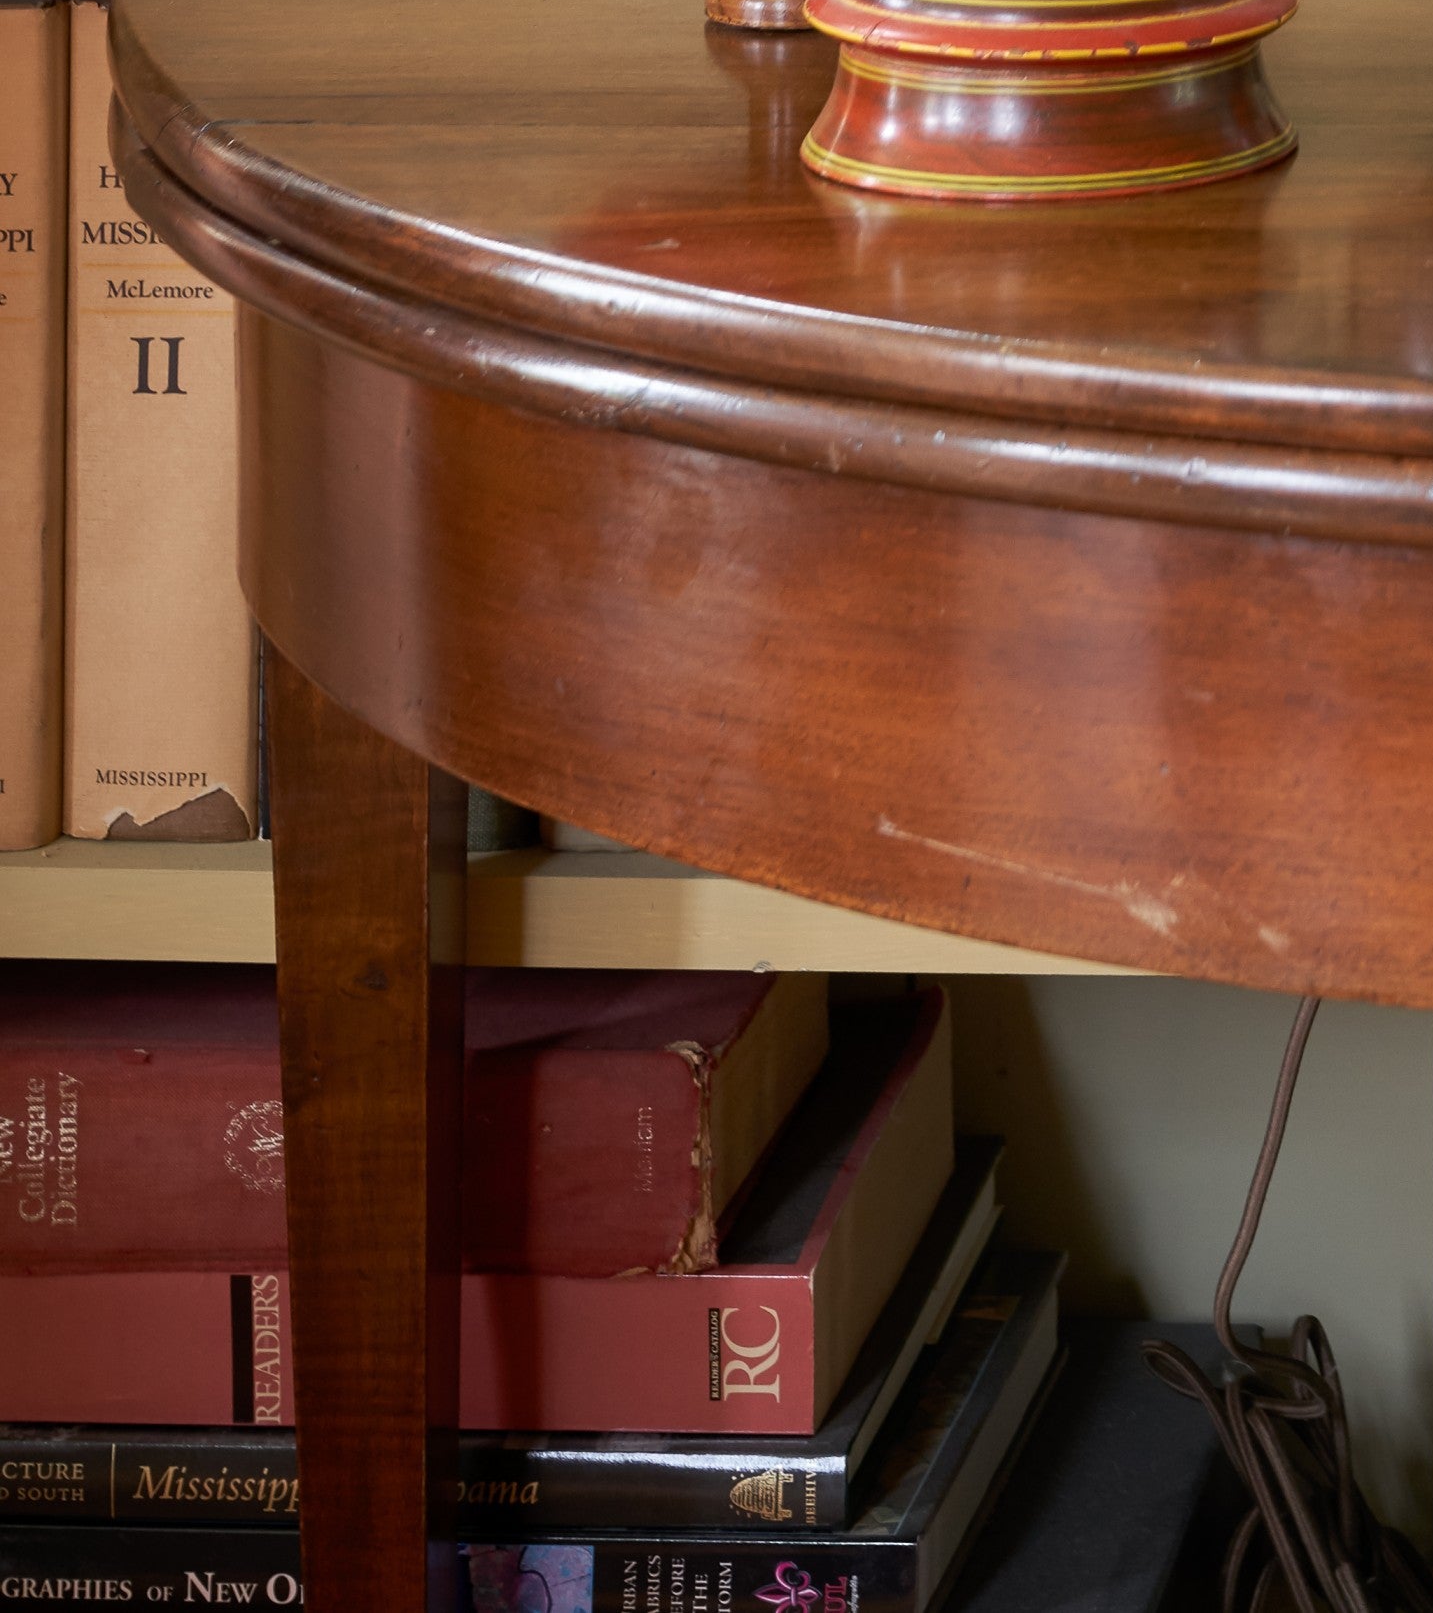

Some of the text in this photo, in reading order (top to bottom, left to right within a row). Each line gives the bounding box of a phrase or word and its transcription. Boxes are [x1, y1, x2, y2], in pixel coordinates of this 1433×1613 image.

[107, 281, 212, 300] McLemore
[132, 336, 188, 396] II
[95, 768, 208, 789] MISSISSIPPI
